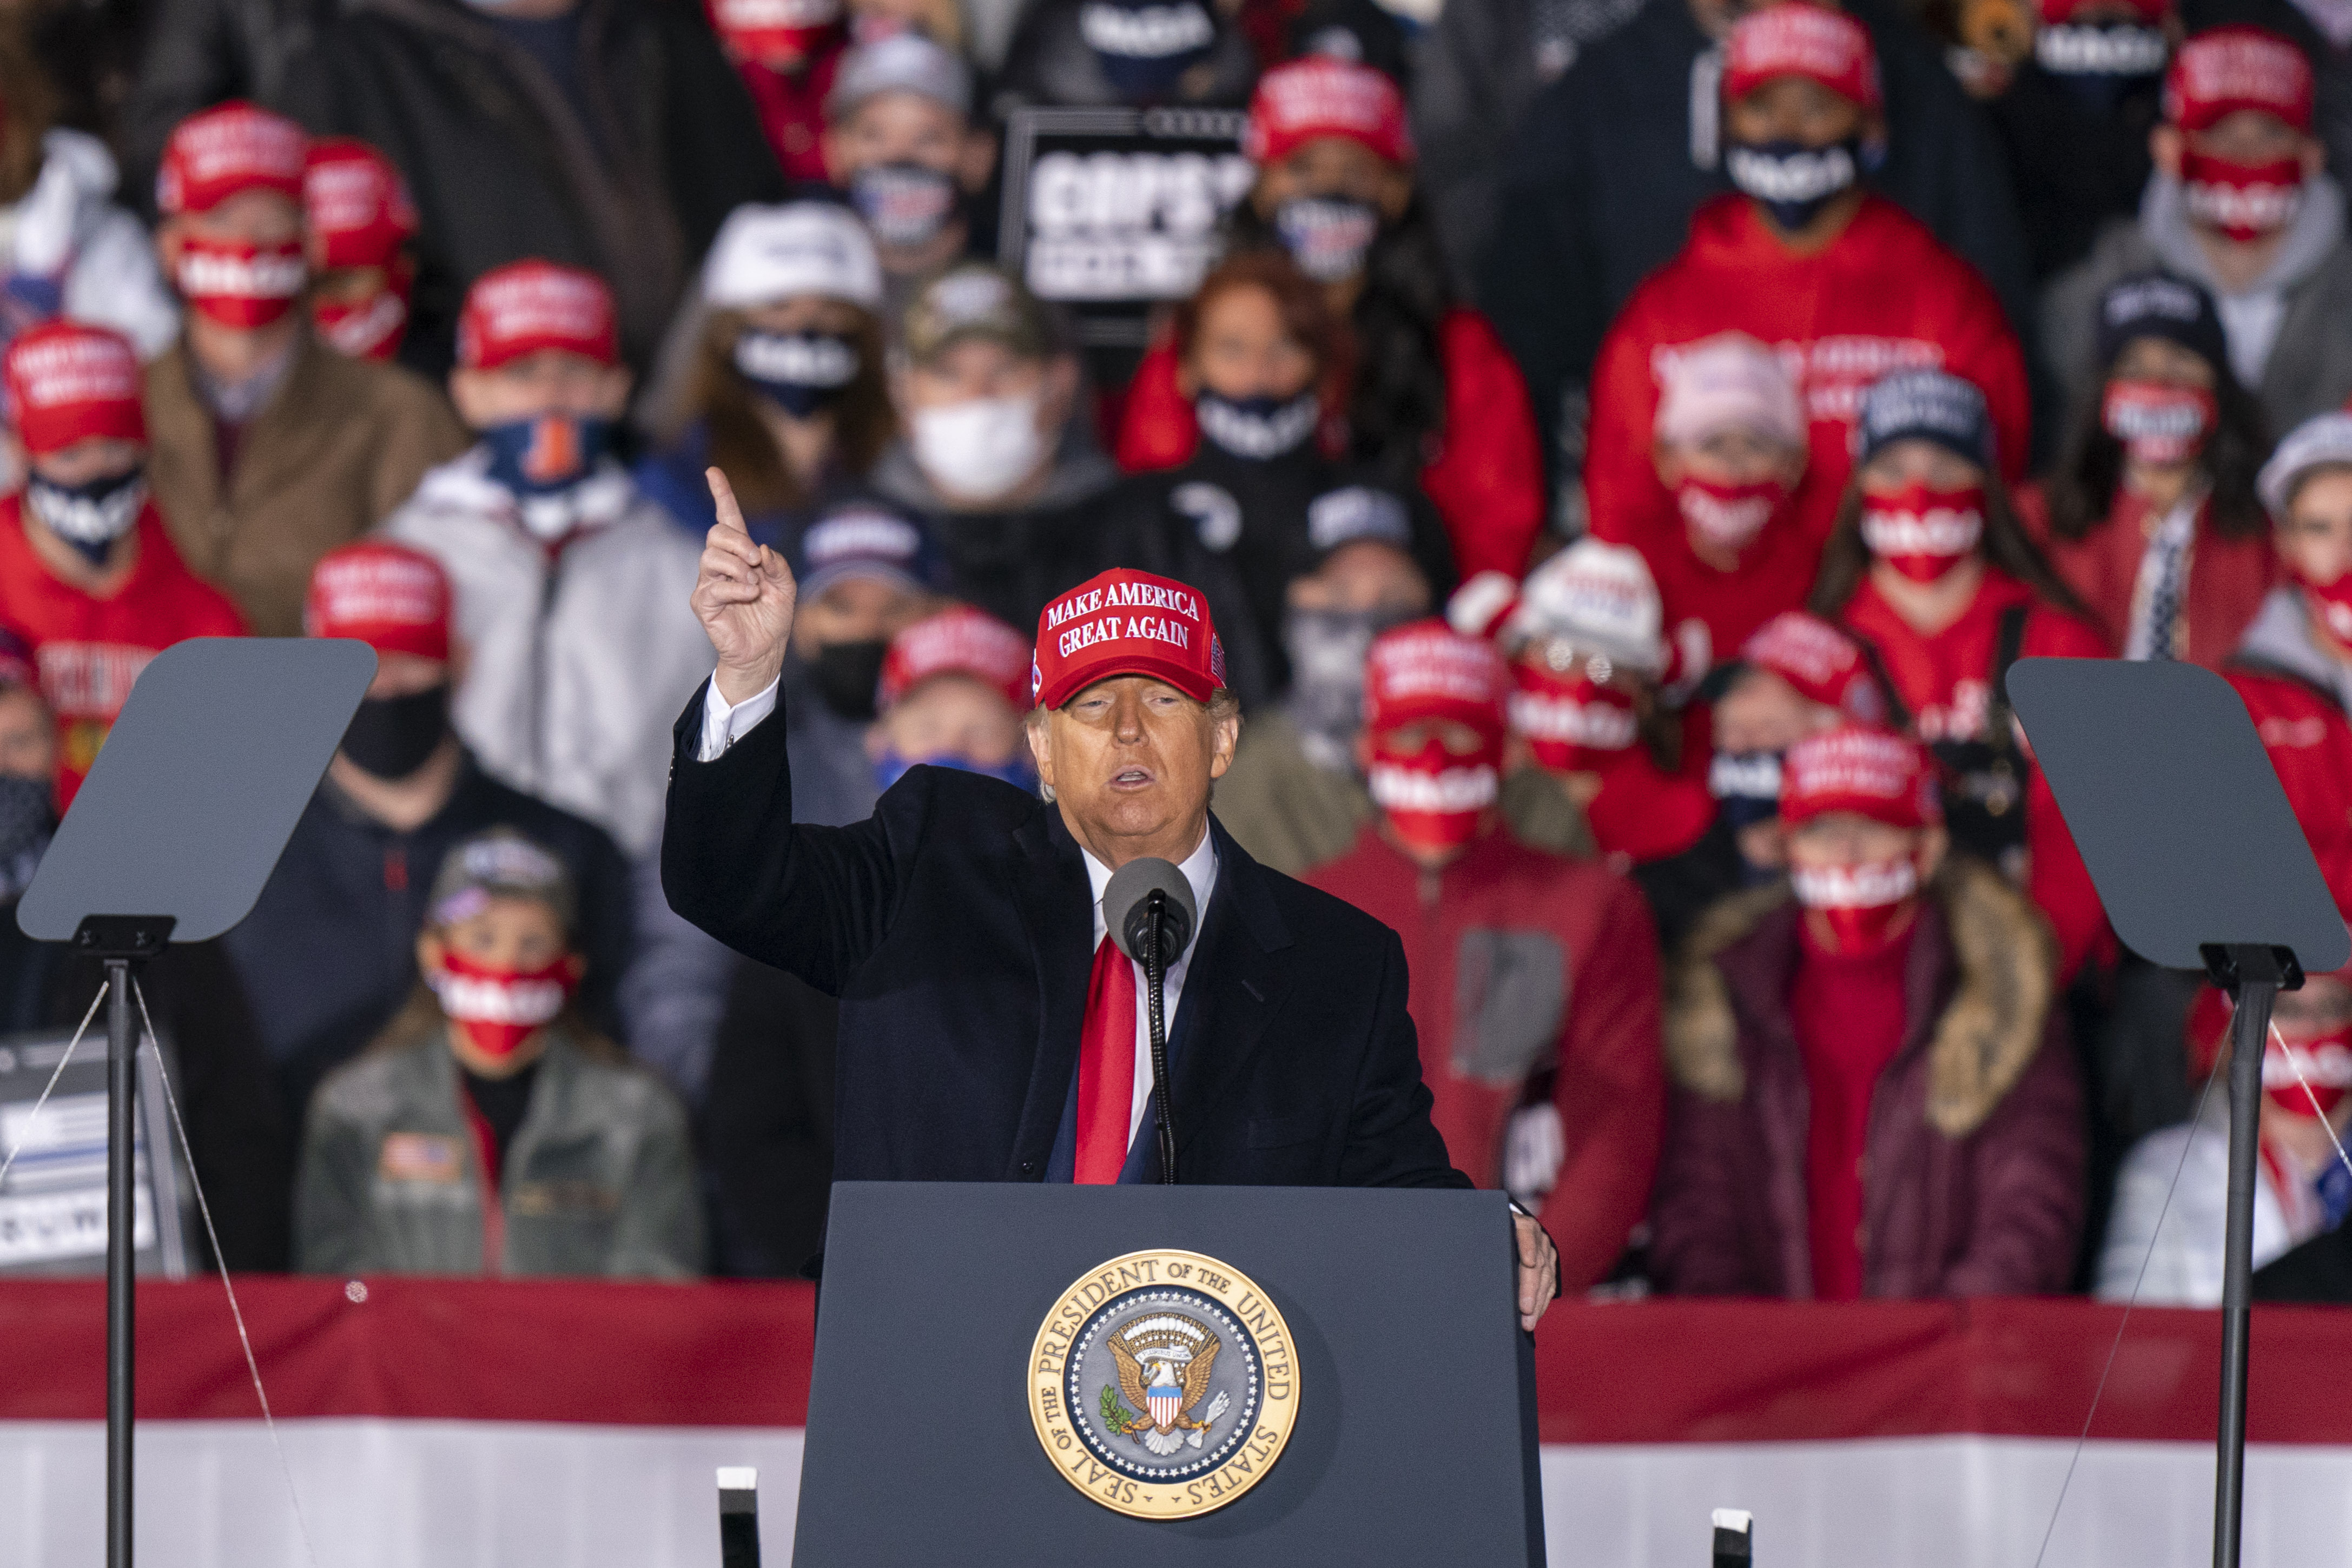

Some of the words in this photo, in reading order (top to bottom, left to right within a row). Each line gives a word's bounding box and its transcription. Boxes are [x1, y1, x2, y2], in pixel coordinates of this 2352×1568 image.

[1047, 588, 1102, 631] MAKE
[1105, 582, 1199, 621] AMERICA
[1059, 617, 1121, 658] GREAT
[1125, 617, 1189, 650] AGAIN
[1167, 1262, 1192, 1279] OF
[1198, 1267, 1231, 1294] THE
[1039, 1259, 1159, 1375] PRESIDENT
[1237, 1291, 1290, 1400] UNITED
[1041, 1386, 1061, 1422] THE
[1052, 1427, 1072, 1451] OF
[1072, 1450, 1139, 1504] SEAL
[1187, 1425, 1278, 1505] STATES
